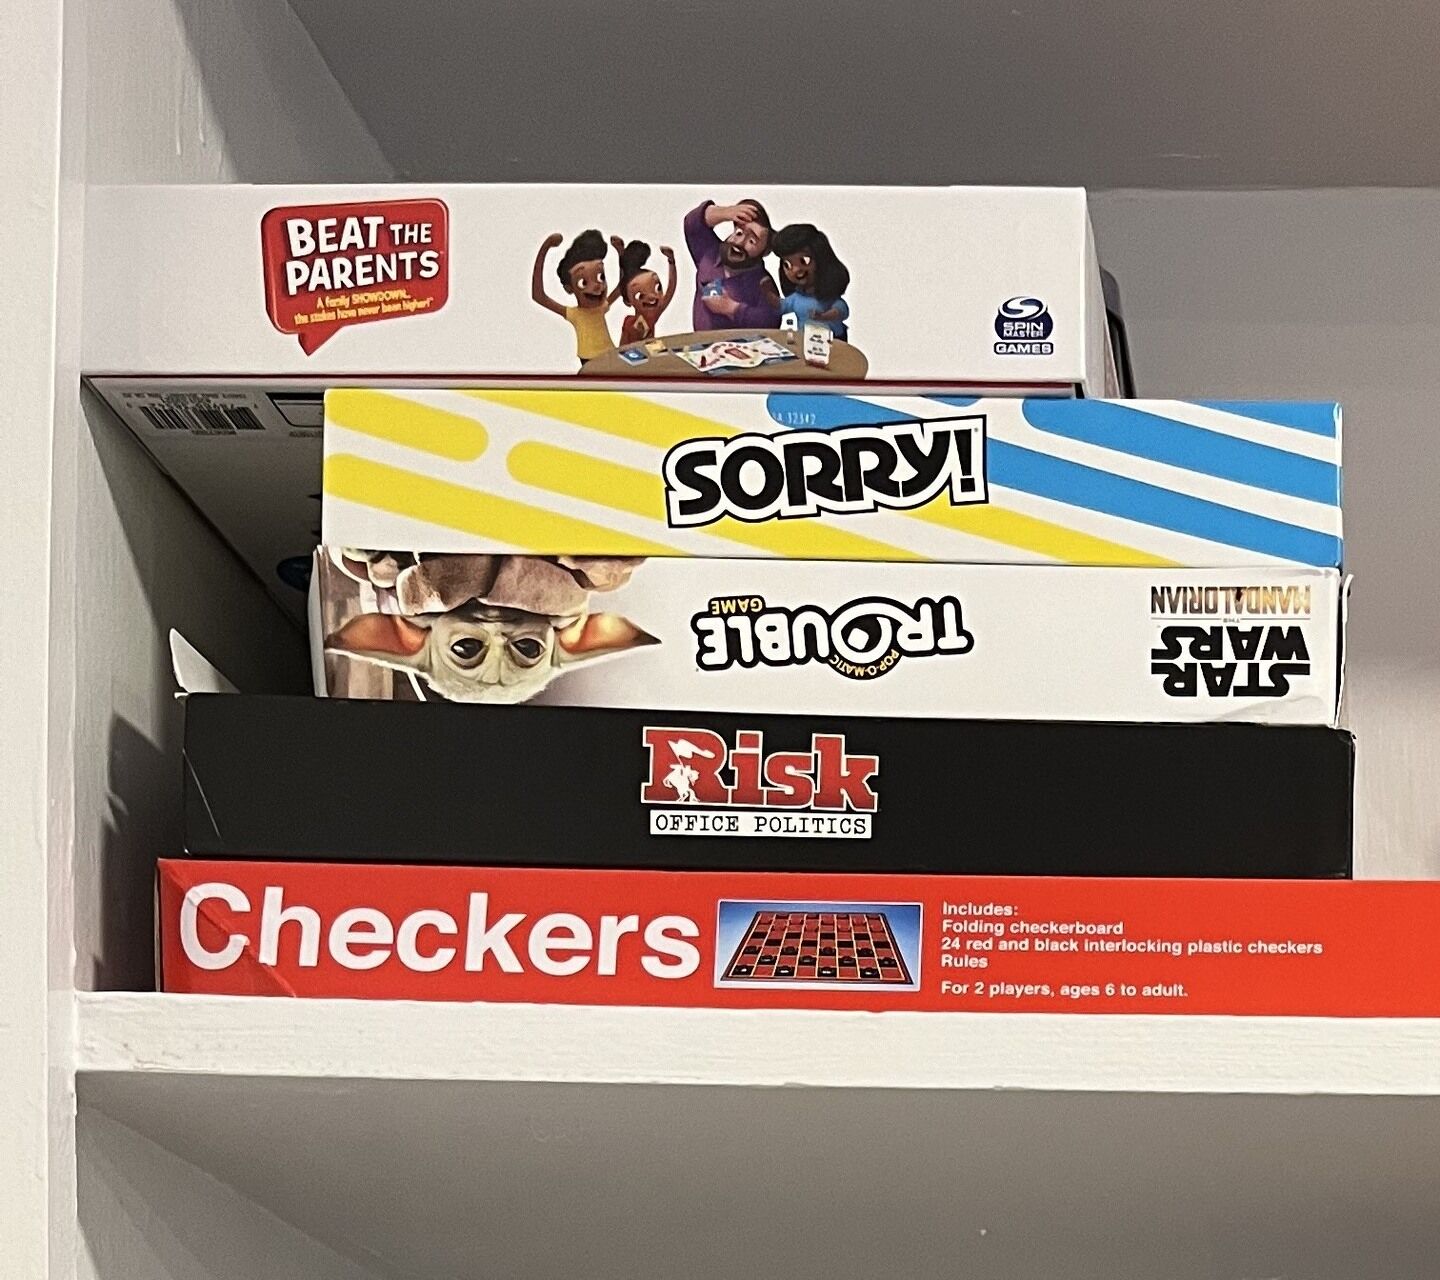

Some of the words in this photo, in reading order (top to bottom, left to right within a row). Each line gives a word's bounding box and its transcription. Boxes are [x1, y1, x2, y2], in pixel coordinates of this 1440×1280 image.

[287, 216, 385, 257] BEAT
[390, 223, 433, 246] THE
[286, 250, 440, 296] PARENTS
[1002, 322, 1044, 331] SPIN
[995, 343, 1052, 354] GAMES
[672, 426, 978, 517] SORRY!
[711, 597, 763, 615] GAME
[1151, 585, 1311, 615] MANDALORIAN
[695, 602, 970, 666] TROUBLE
[1150, 625, 1311, 661] WARS
[1150, 662, 1311, 698] STAR
[641, 725, 879, 812] Risk
[655, 814, 740, 832] OFFICE
[754, 816, 869, 835] POLITICS
[942, 902, 1019, 917] Includes:
[179, 882, 701, 980] Checkers
[942, 920, 1005, 937] Folding
[1010, 920, 1124, 936] checkerboard
[941, 938, 961, 951] 24
[966, 938, 993, 951] red
[998, 939, 1030, 952] and
[1034, 939, 1079, 953] black
[1084, 939, 1182, 956] interlocking
[1187, 940, 1243, 956] plastic
[1248, 941, 1323, 955] checkers
[941, 955, 989, 969] Rules
[941, 981, 970, 995] For
[974, 982, 985, 995] 2
[989, 982, 1056, 999] players,
[1060, 985, 1100, 999] ages
[1105, 983, 1115, 996] 6
[1120, 983, 1137, 997] to
[1142, 984, 1189, 998] adult.
